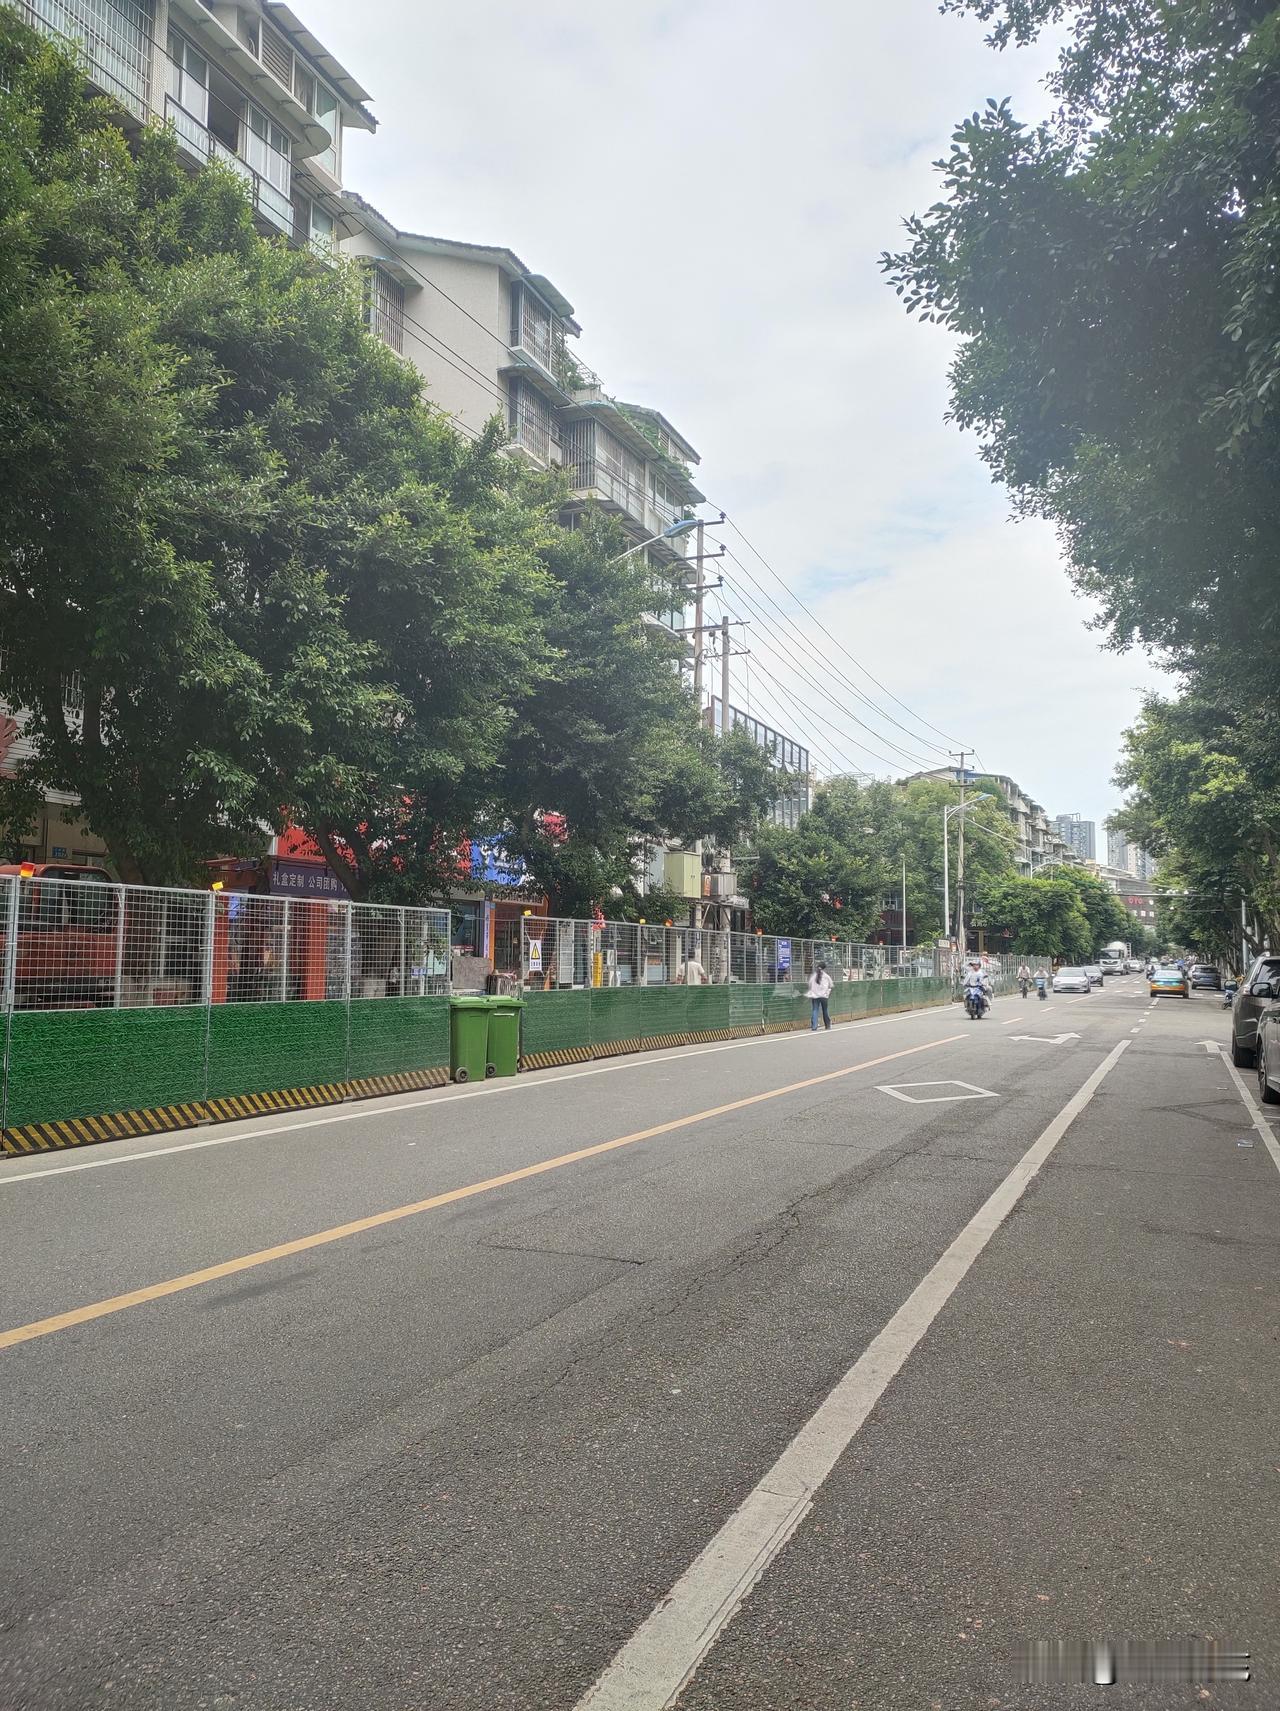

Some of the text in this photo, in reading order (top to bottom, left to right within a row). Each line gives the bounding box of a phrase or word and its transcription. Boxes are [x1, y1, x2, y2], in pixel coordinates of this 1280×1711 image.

[273, 872, 305, 888] 礼盒定制
[308, 875, 338, 891] 公司团购
